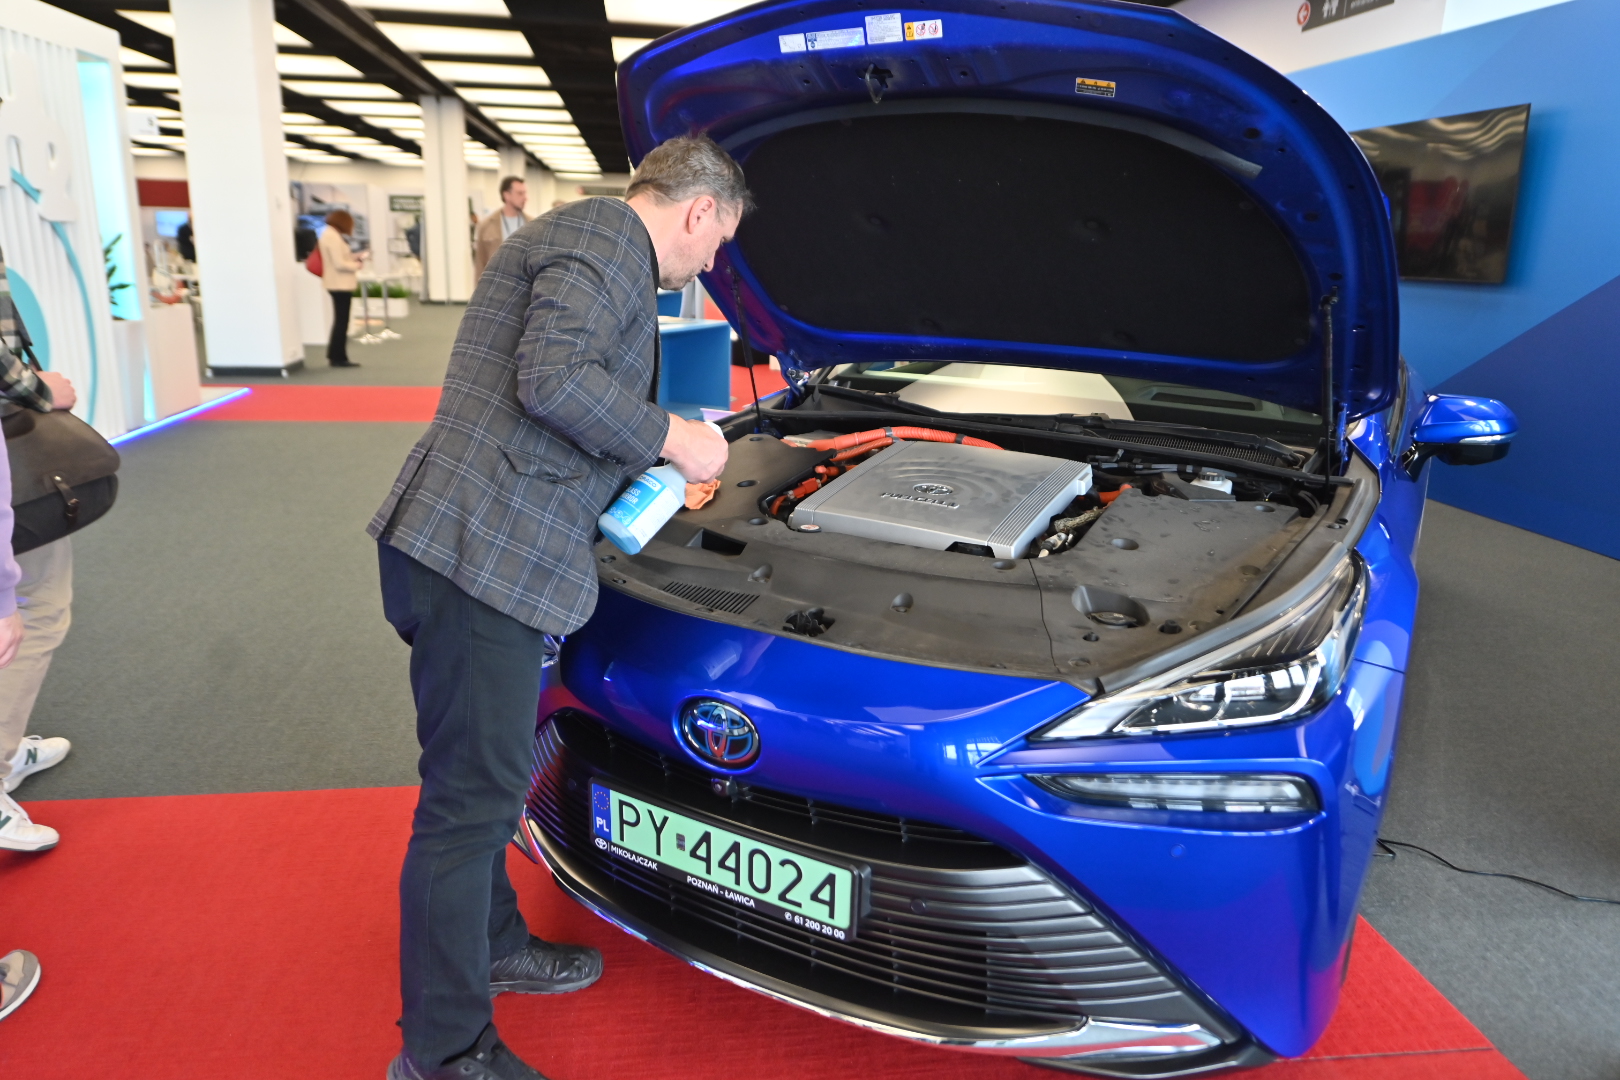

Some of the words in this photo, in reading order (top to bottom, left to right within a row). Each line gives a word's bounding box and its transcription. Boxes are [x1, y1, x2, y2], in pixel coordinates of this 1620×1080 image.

[596, 816, 610, 833] PL
[611, 845, 658, 871] MIKOŁAJCZAK
[618, 799, 670, 857] PY
[689, 831, 836, 920] 44024
[687, 875, 719, 895] POZNAŃ
[725, 889, 755, 908] ŁAWICA
[794, 915, 804, 925] 61
[805, 918, 821, 932] 200
[822, 924, 833, 936] 20
[834, 929, 846, 940] 00
